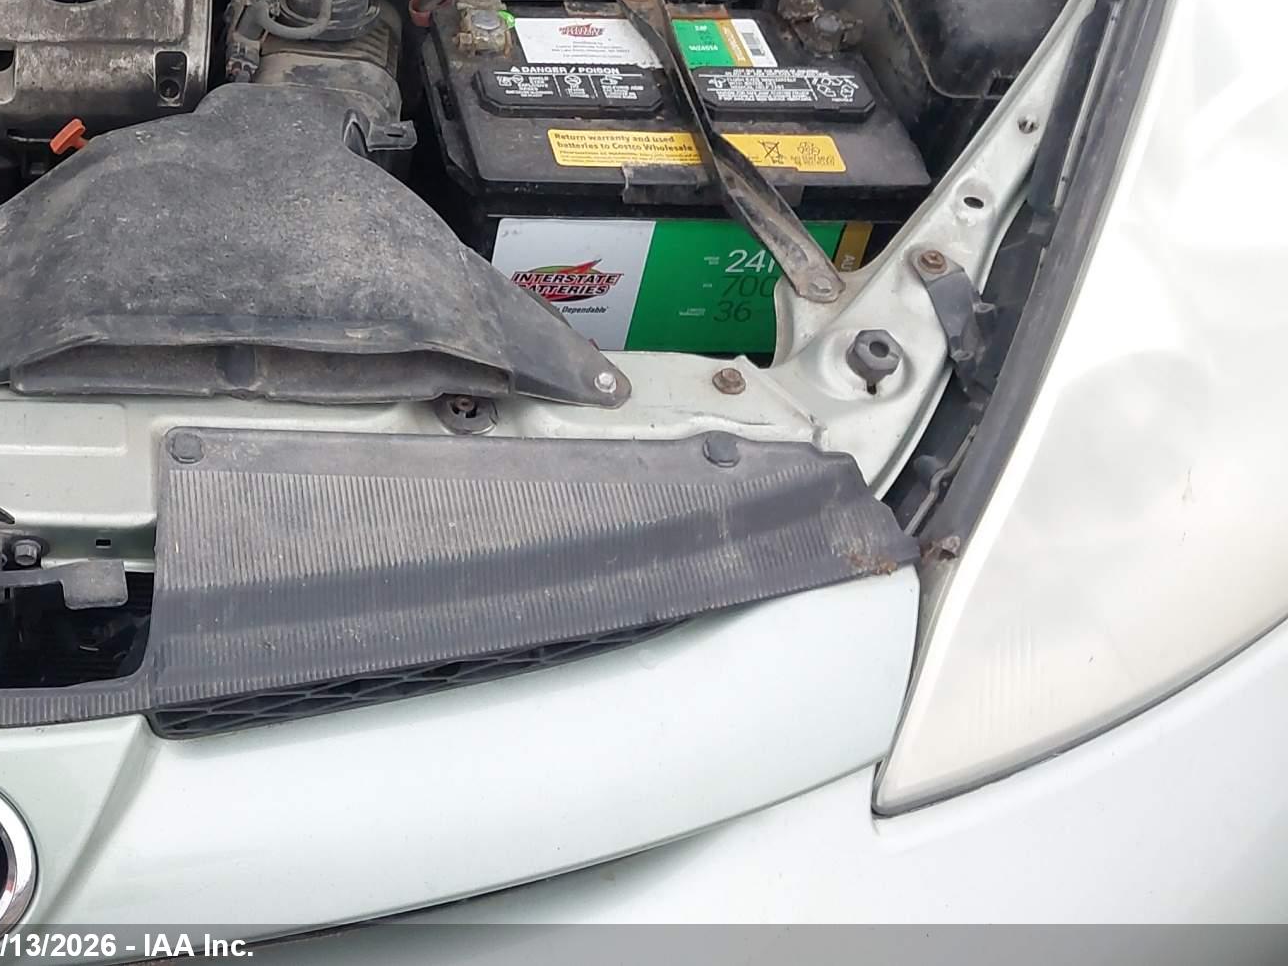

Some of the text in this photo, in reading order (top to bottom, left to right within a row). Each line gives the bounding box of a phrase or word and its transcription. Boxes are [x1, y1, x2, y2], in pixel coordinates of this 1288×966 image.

[521, 66, 568, 74] DANGER
[578, 66, 620, 74] POISON
[555, 133, 586, 141] Return
[588, 135, 630, 143] warranty
[557, 141, 599, 149] batteries
[512, 272, 620, 285] INTERSTATE
[519, 284, 610, 296] ATTERIES
[561, 306, 607, 315] Dependable
[713, 301, 752, 322] 36
